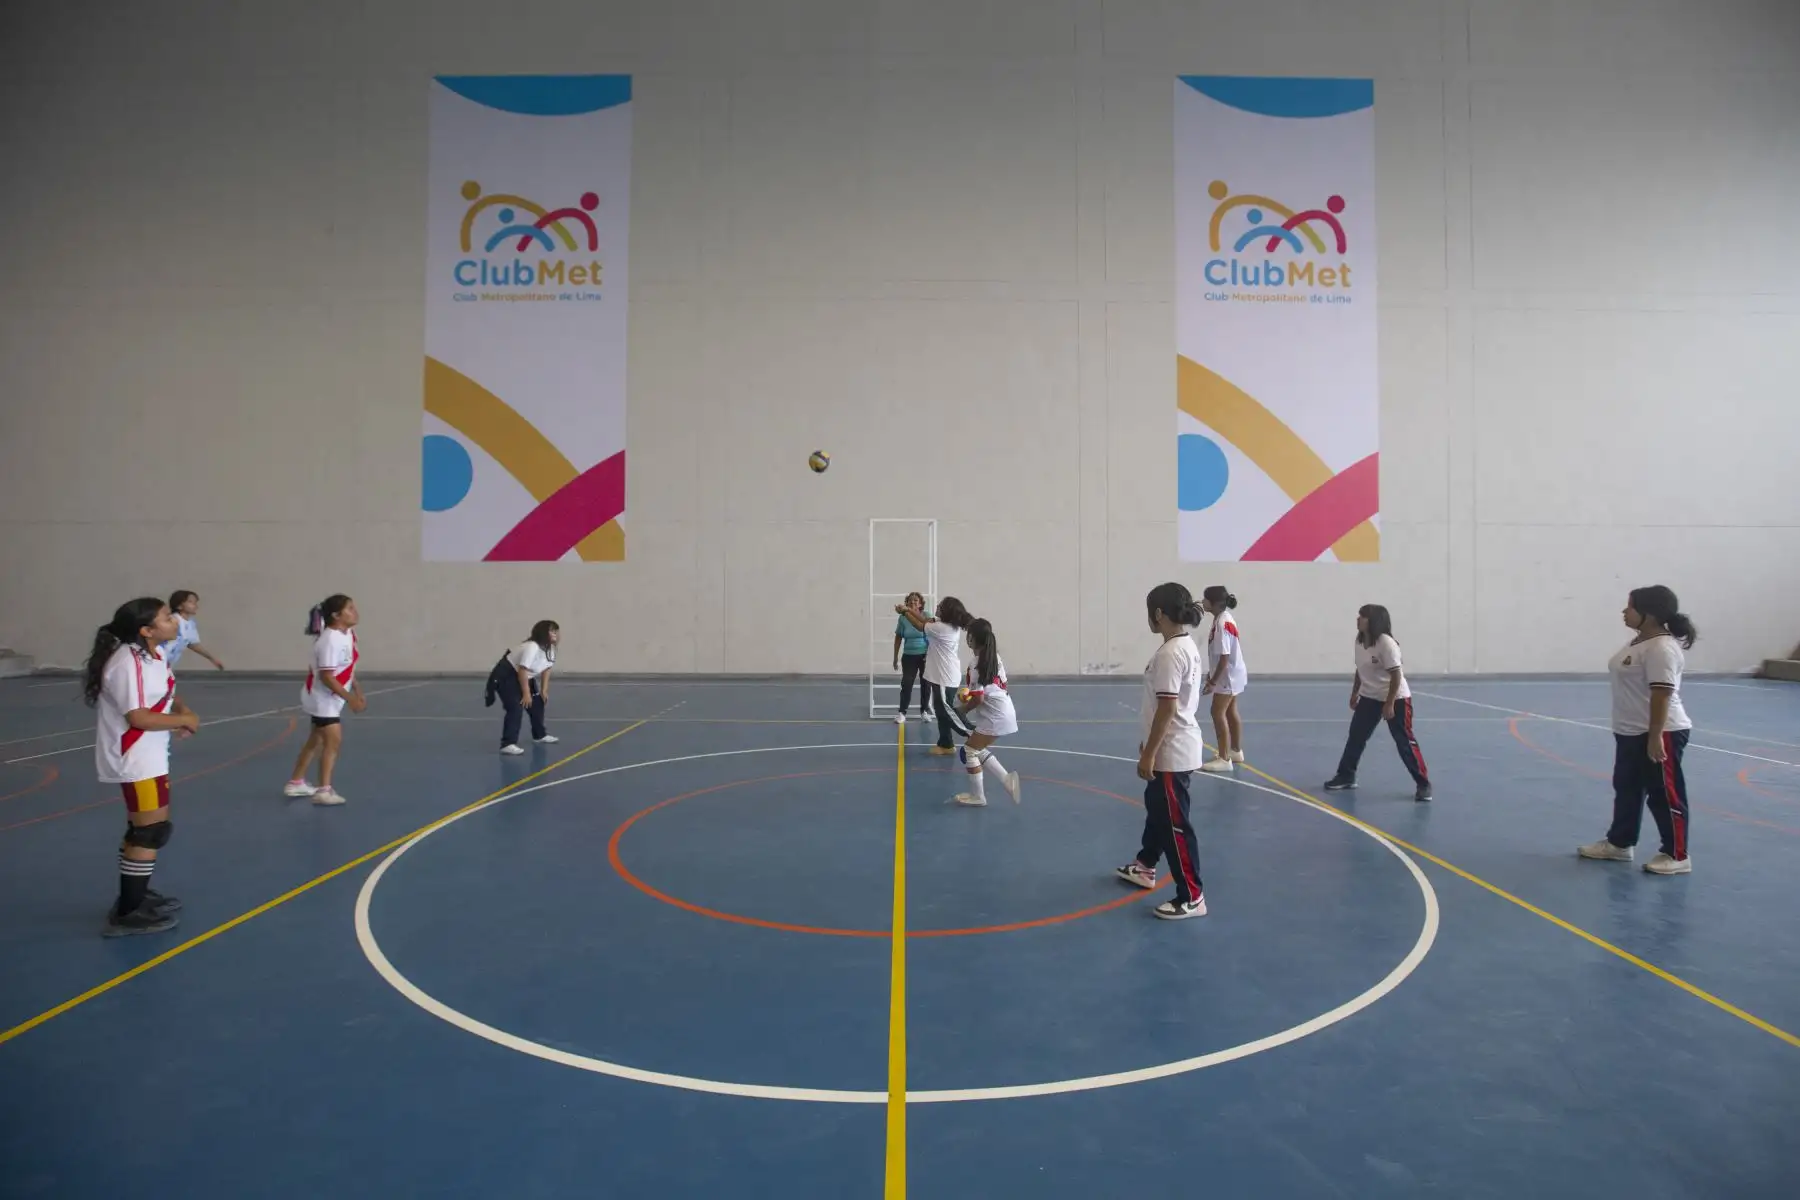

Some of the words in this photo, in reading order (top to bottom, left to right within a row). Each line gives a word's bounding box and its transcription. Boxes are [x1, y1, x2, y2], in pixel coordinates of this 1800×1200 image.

[453, 258, 603, 287] ClubMet
[1203, 258, 1352, 288] ClubMet
[453, 292, 478, 302] Club
[481, 292, 557, 304] Metropolitano
[559, 291, 573, 301] de
[576, 291, 602, 301] Lima
[1204, 291, 1229, 302] Club
[1232, 292, 1307, 304] Metropolitano
[1310, 293, 1324, 304] de
[1327, 293, 1352, 304] Lima
